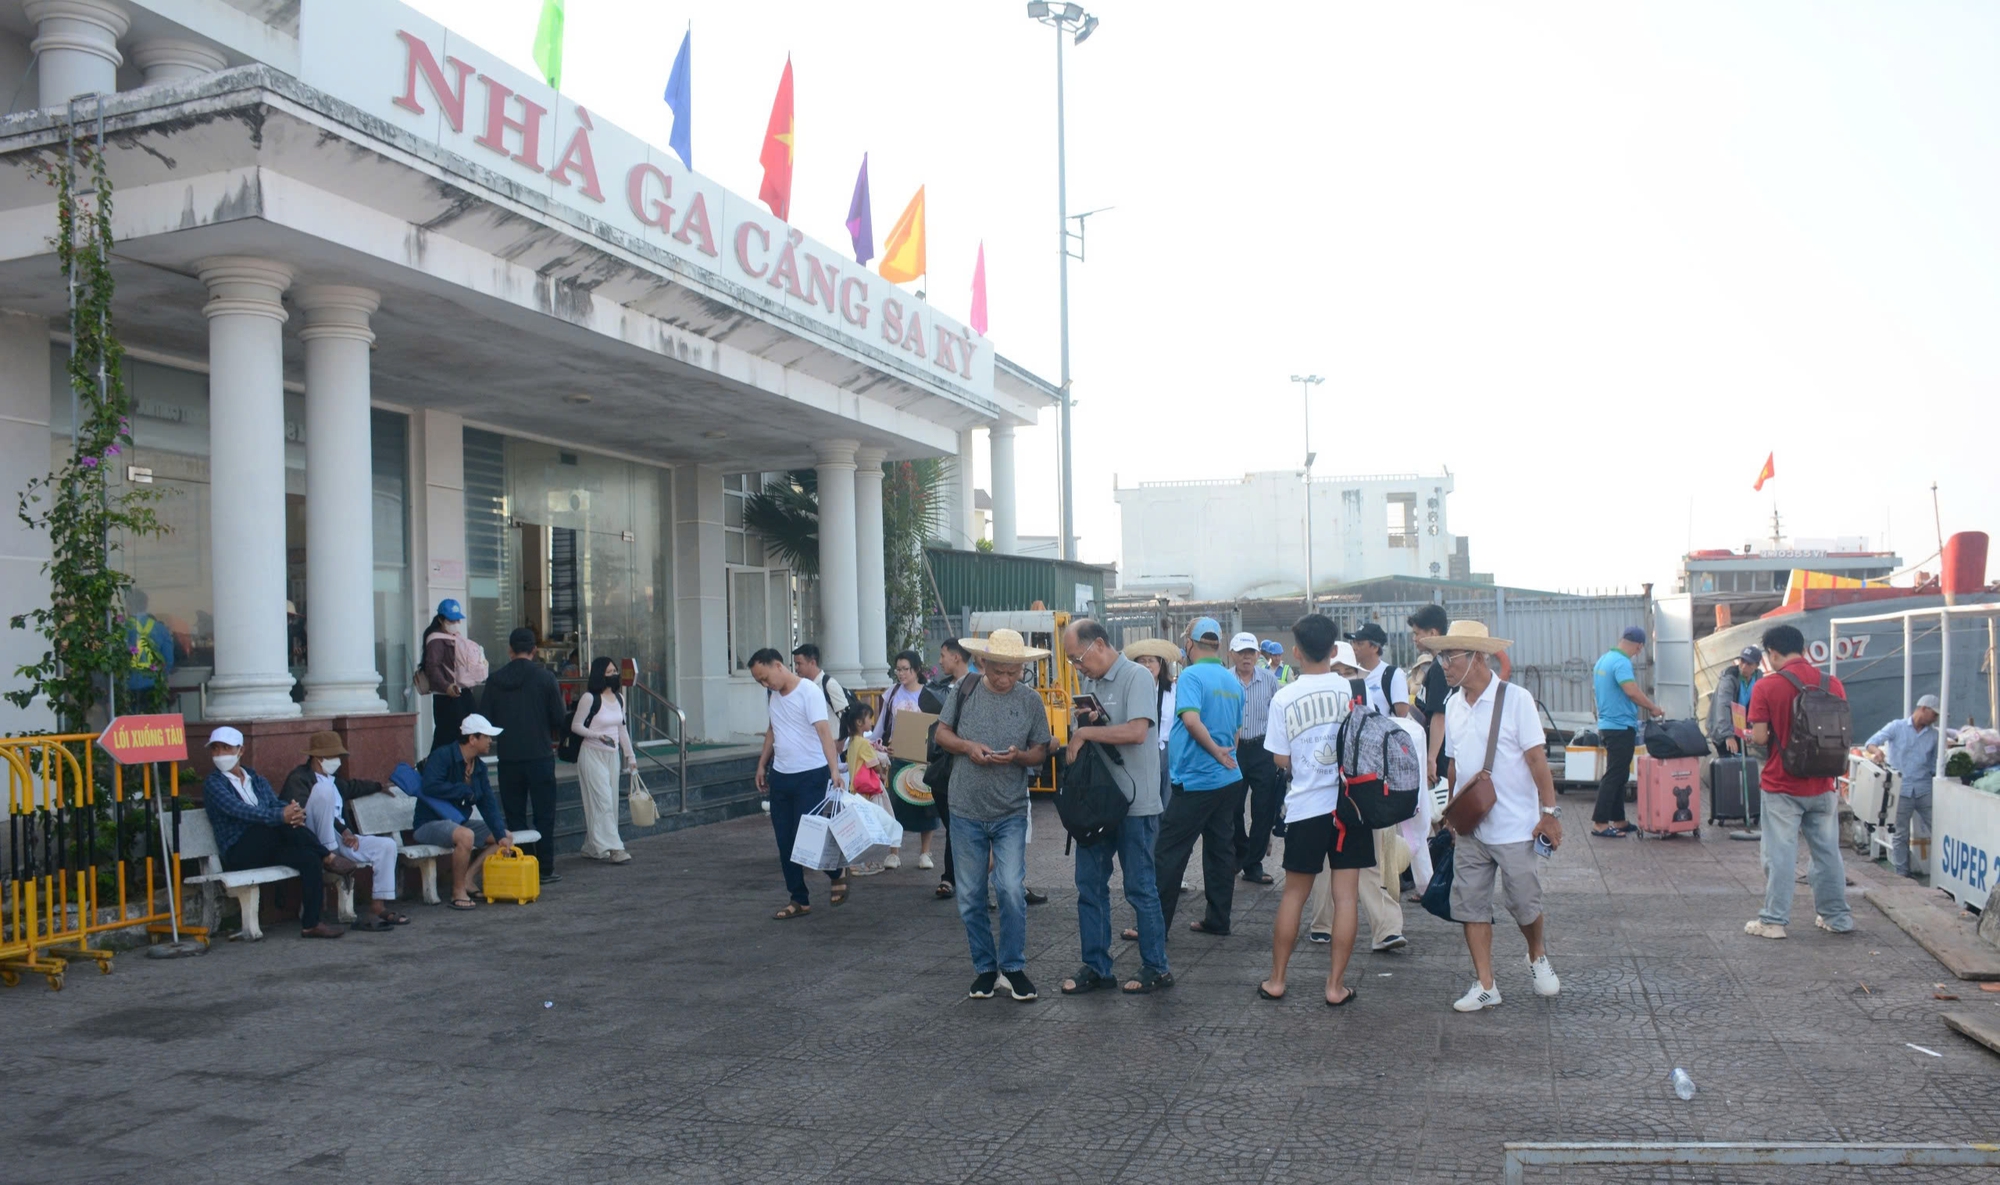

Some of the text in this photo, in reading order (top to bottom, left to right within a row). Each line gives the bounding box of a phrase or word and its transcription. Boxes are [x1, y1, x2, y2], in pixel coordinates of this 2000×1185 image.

[391, 29, 978, 381] NHÀ GA CẢNG SA KỲ
[113, 722, 184, 749] LỐI XUỐNG TÀU
[1942, 834, 1987, 893] SUPER
